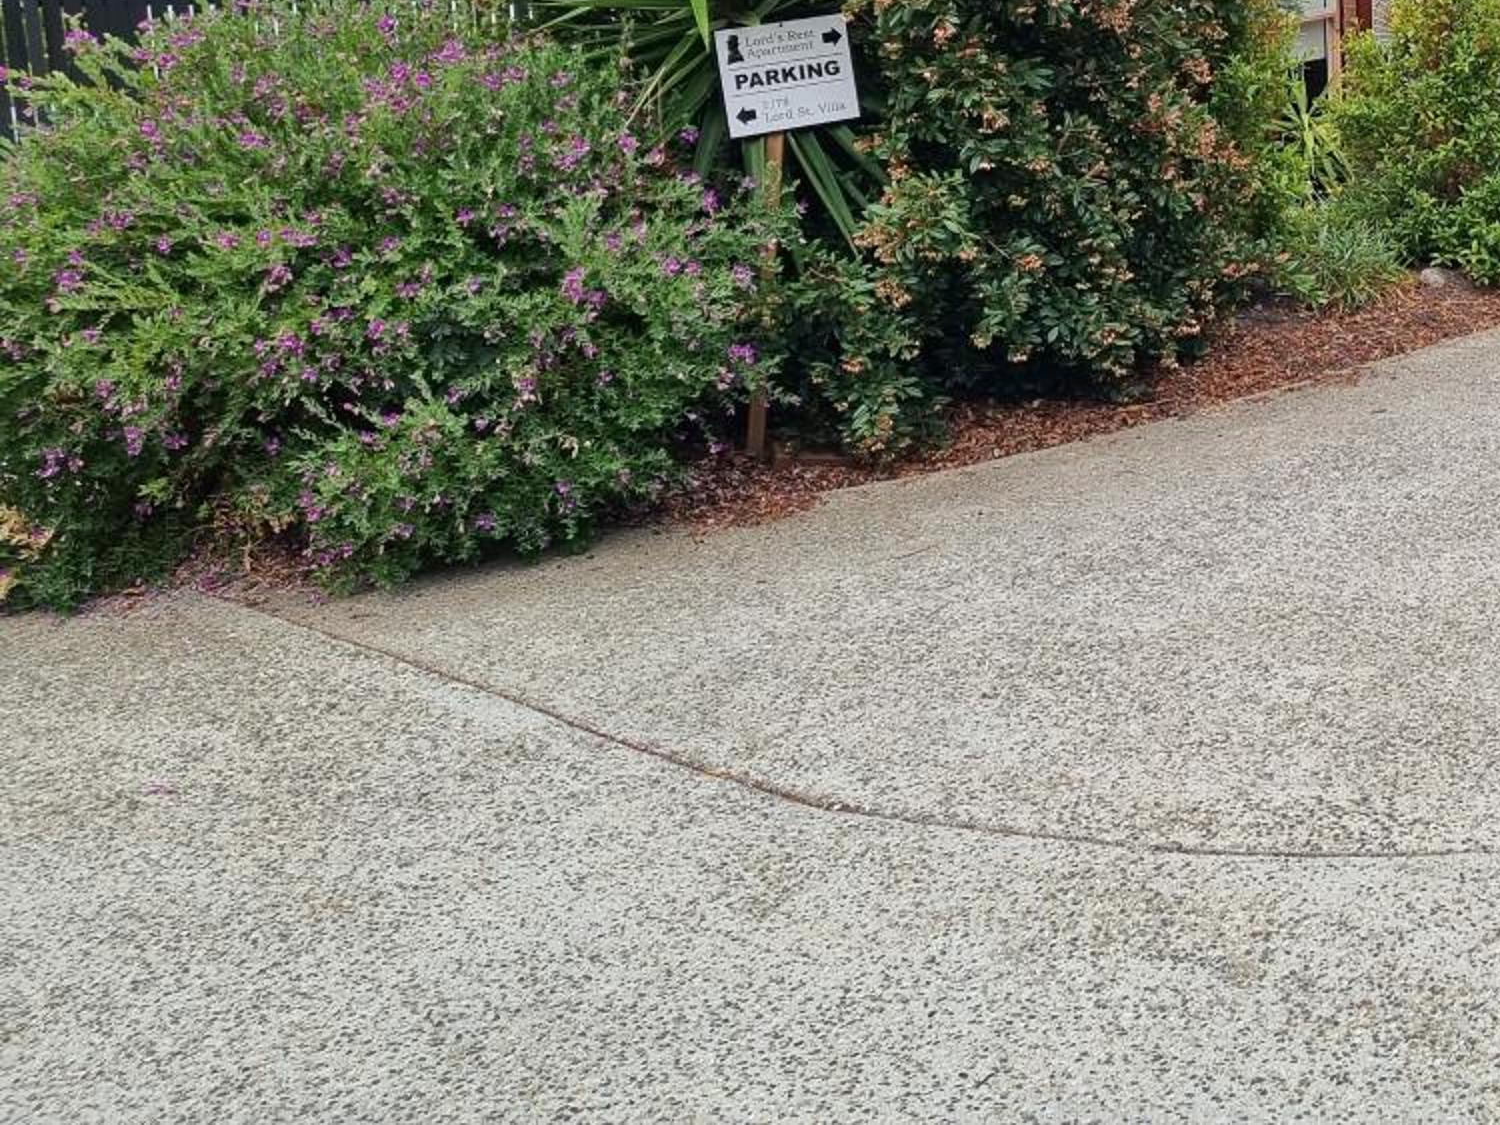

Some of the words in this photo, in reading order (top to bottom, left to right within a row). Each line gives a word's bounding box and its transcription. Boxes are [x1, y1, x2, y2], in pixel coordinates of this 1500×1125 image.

[745, 31, 783, 48] Lord's
[787, 29, 817, 41] Rest
[747, 40, 815, 59] Apartment
[735, 60, 841, 90] PARKING
